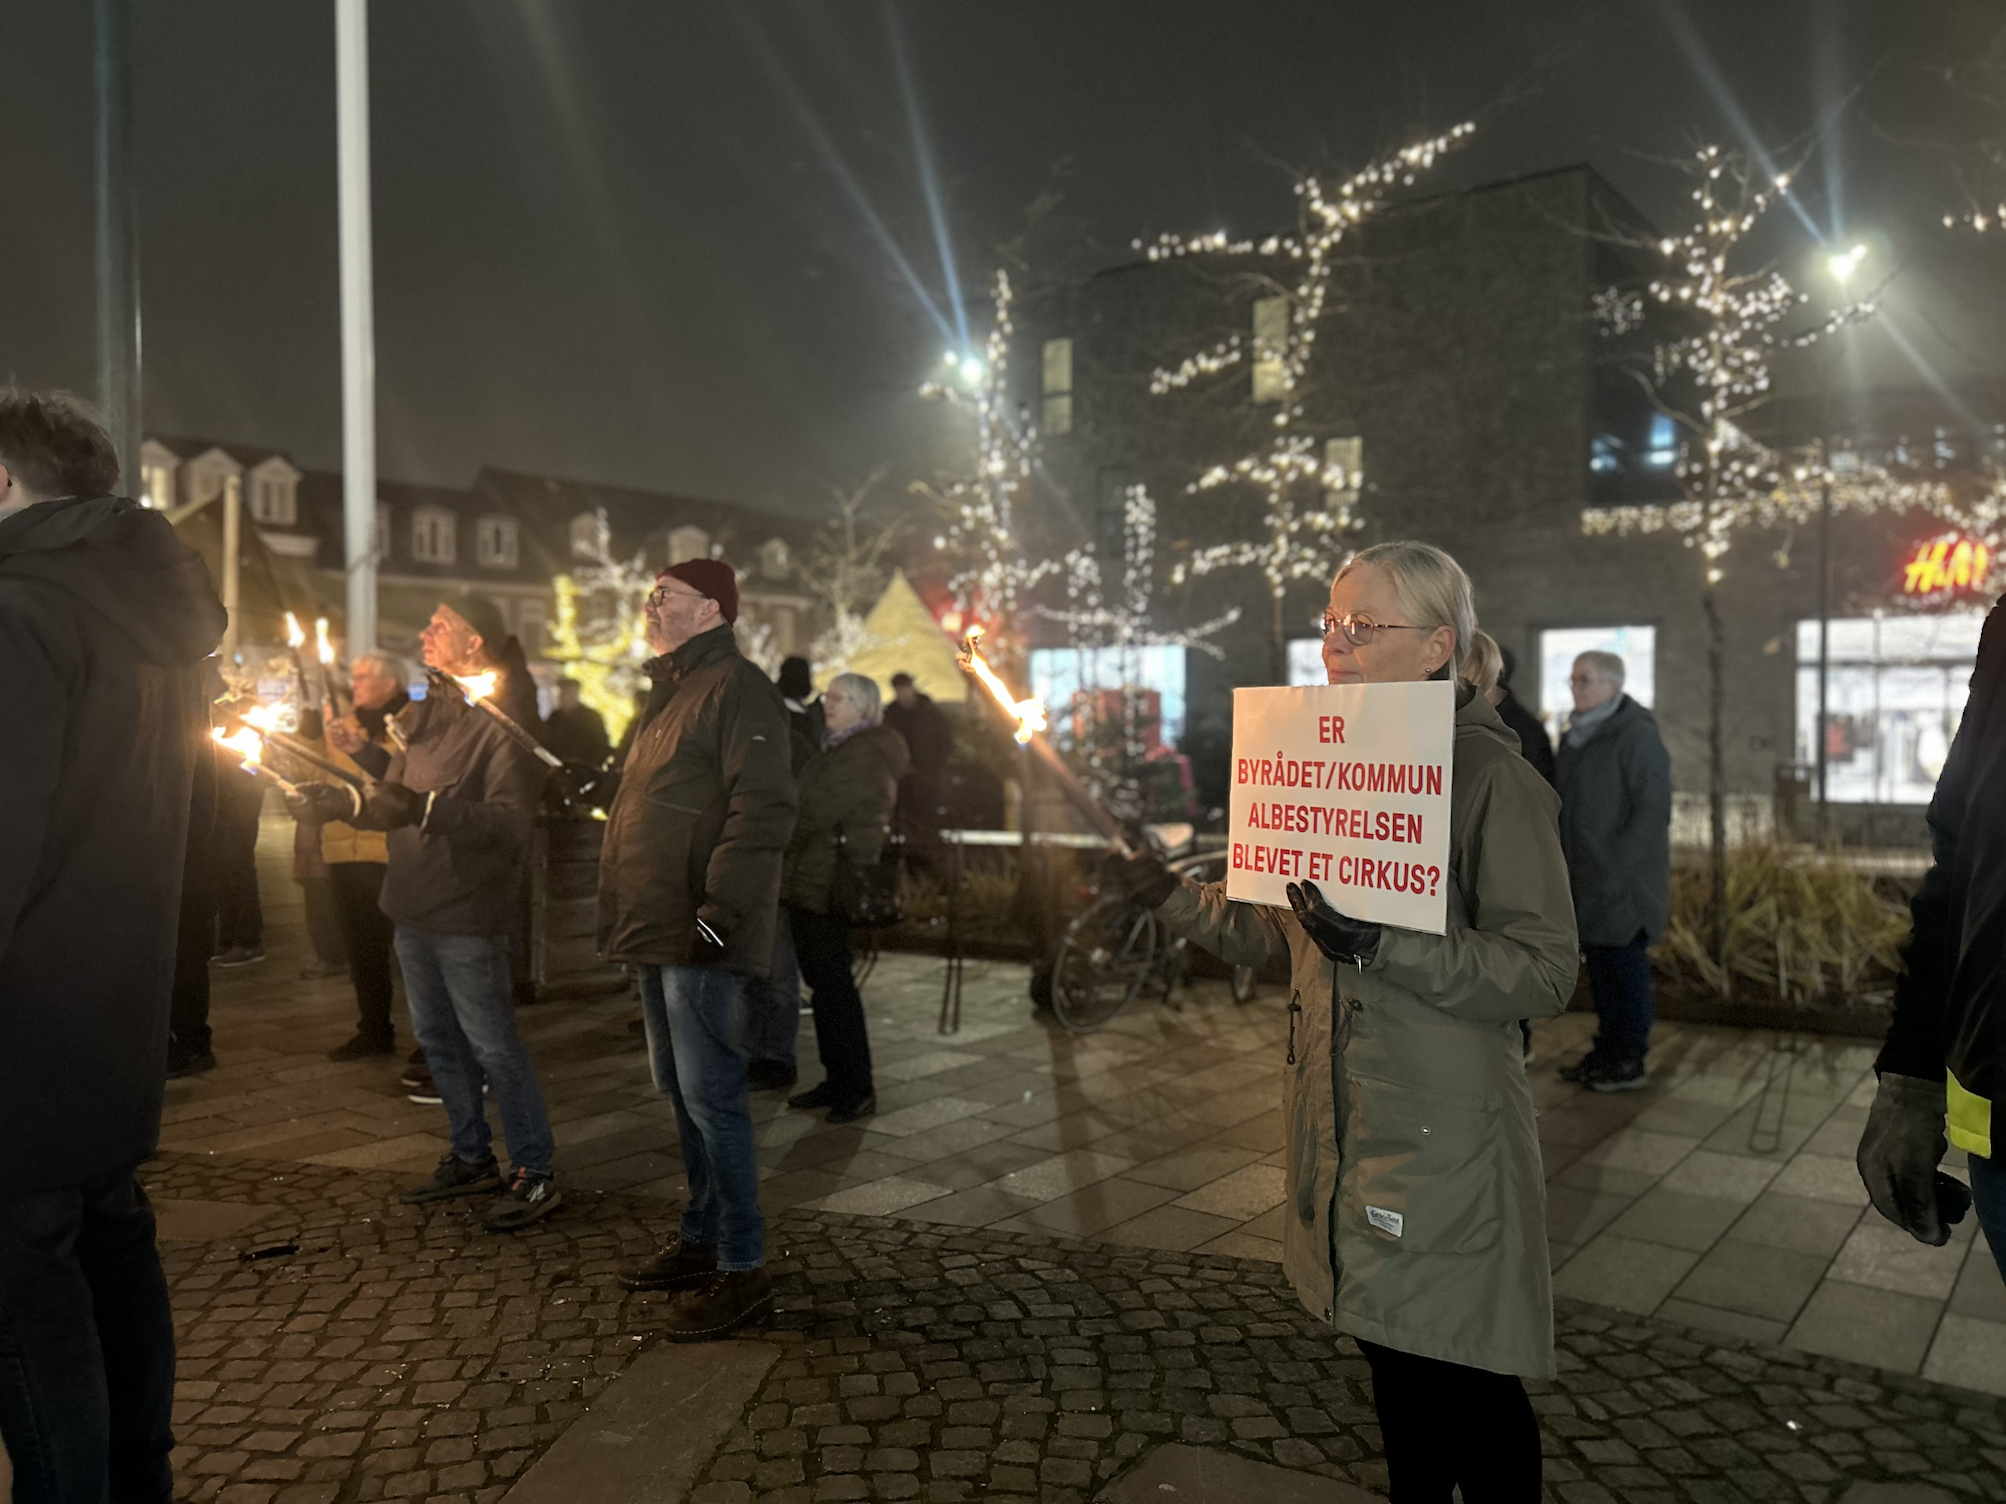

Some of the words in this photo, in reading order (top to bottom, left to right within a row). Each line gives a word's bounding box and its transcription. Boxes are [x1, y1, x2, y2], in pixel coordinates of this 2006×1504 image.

[1318, 715, 1345, 744] ER
[1238, 751, 1442, 795] BYRÅDET/KOMMUN
[1248, 803, 1422, 843] ALBESTYRELSEN
[1233, 843, 1303, 877] BLEVET
[1308, 851, 1334, 881] ET
[1338, 855, 1441, 897] CIRKUS?
